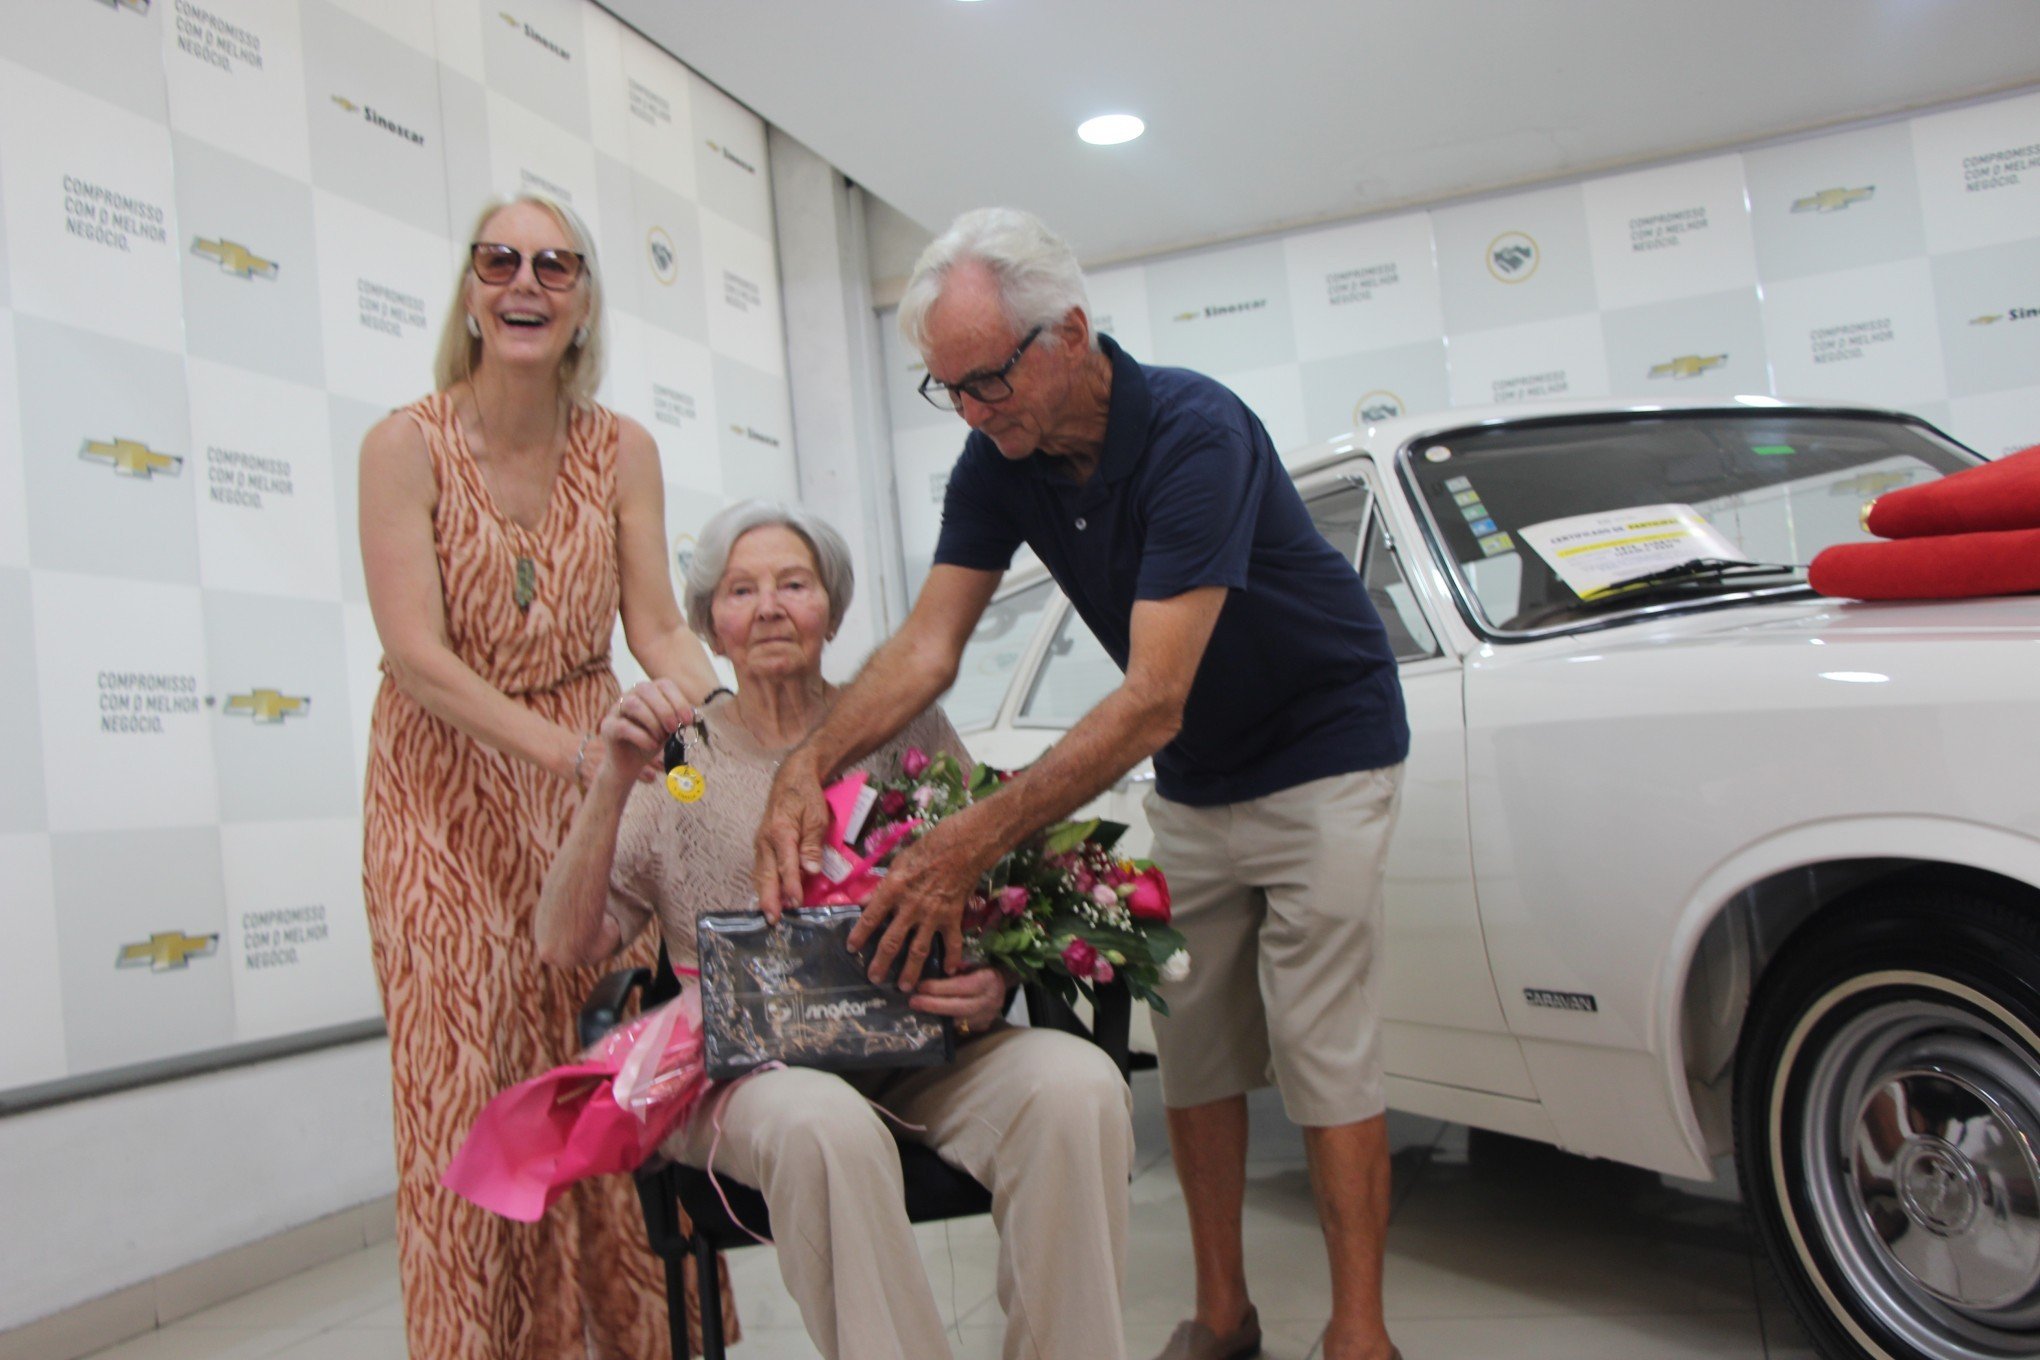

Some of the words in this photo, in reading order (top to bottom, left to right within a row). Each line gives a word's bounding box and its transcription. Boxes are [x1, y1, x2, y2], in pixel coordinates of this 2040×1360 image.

[174, 0, 261, 51] COMPROMISSO
[176, 15, 203, 39] COM
[206, 28, 214, 47] O
[216, 33, 263, 70] MELHOR
[364, 104, 424, 147] Sinoscar
[1965, 167, 1989, 180] COM
[1993, 164, 2001, 175] O
[63, 173, 164, 224] COMPROMISSO
[65, 194, 96, 217] COM
[99, 207, 109, 226] O
[112, 211, 167, 244] MELHOR
[1629, 206, 1706, 229] COMPROMISSO
[1630, 228, 1654, 241] COM
[1656, 226, 1664, 238] O
[1665, 218, 1708, 233] MELHOR
[1204, 298, 1267, 319] Sinoscar
[2008, 307, 2040, 321] Sin
[1811, 318, 1892, 341] COMPROMISSO
[1812, 339, 1836, 353] COM
[1838, 338, 1846, 349] O
[1848, 330, 1894, 345] MELHOR
[207, 446, 291, 479] COMPROMISSO
[208, 466, 234, 482] COM
[236, 470, 246, 488] O
[247, 473, 293, 498] MELHOR
[98, 672, 197, 693] COMPROMISSO
[99, 692, 130, 711] COM
[133, 693, 142, 712] O
[145, 694, 199, 714] MELHOR
[242, 904, 327, 930] COMPROMISSO
[243, 931, 270, 950] COM
[272, 928, 281, 947] O
[283, 923, 329, 944] MELHOR
